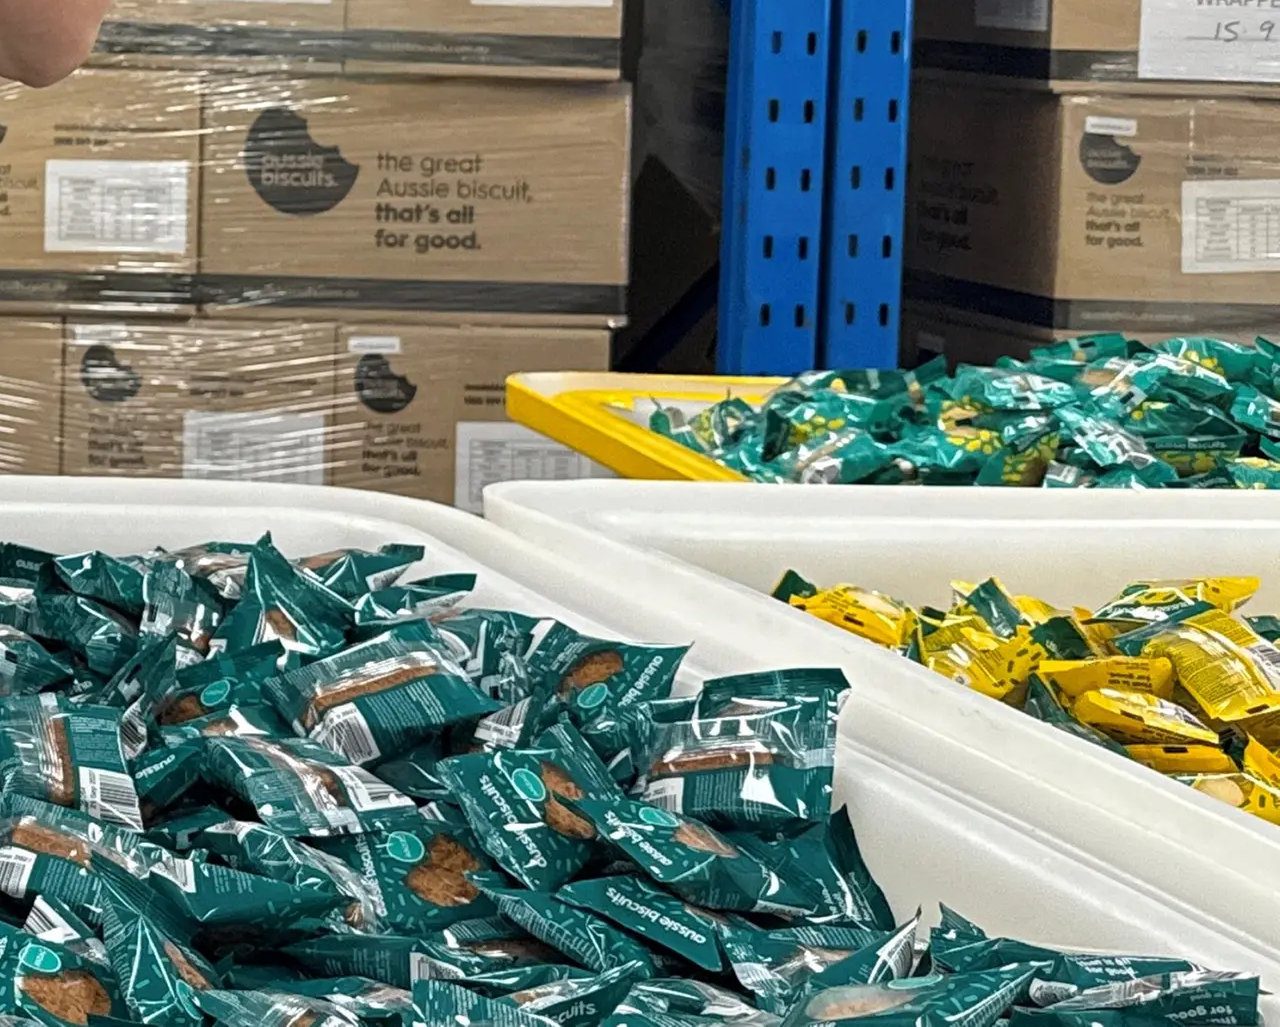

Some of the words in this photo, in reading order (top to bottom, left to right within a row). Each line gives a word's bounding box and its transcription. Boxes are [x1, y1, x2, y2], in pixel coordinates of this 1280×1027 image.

[376, 151, 413, 171] the
[420, 153, 485, 177] great
[375, 178, 450, 198] Aussie
[456, 179, 534, 203] biscuit,
[375, 203, 440, 223] that's
[446, 205, 474, 224] all
[375, 229, 409, 248] for
[414, 230, 482, 253] good.
[606, 887, 660, 923] biscuits
[660, 915, 707, 944] aussie
[550, 1002, 597, 1025] scuits
